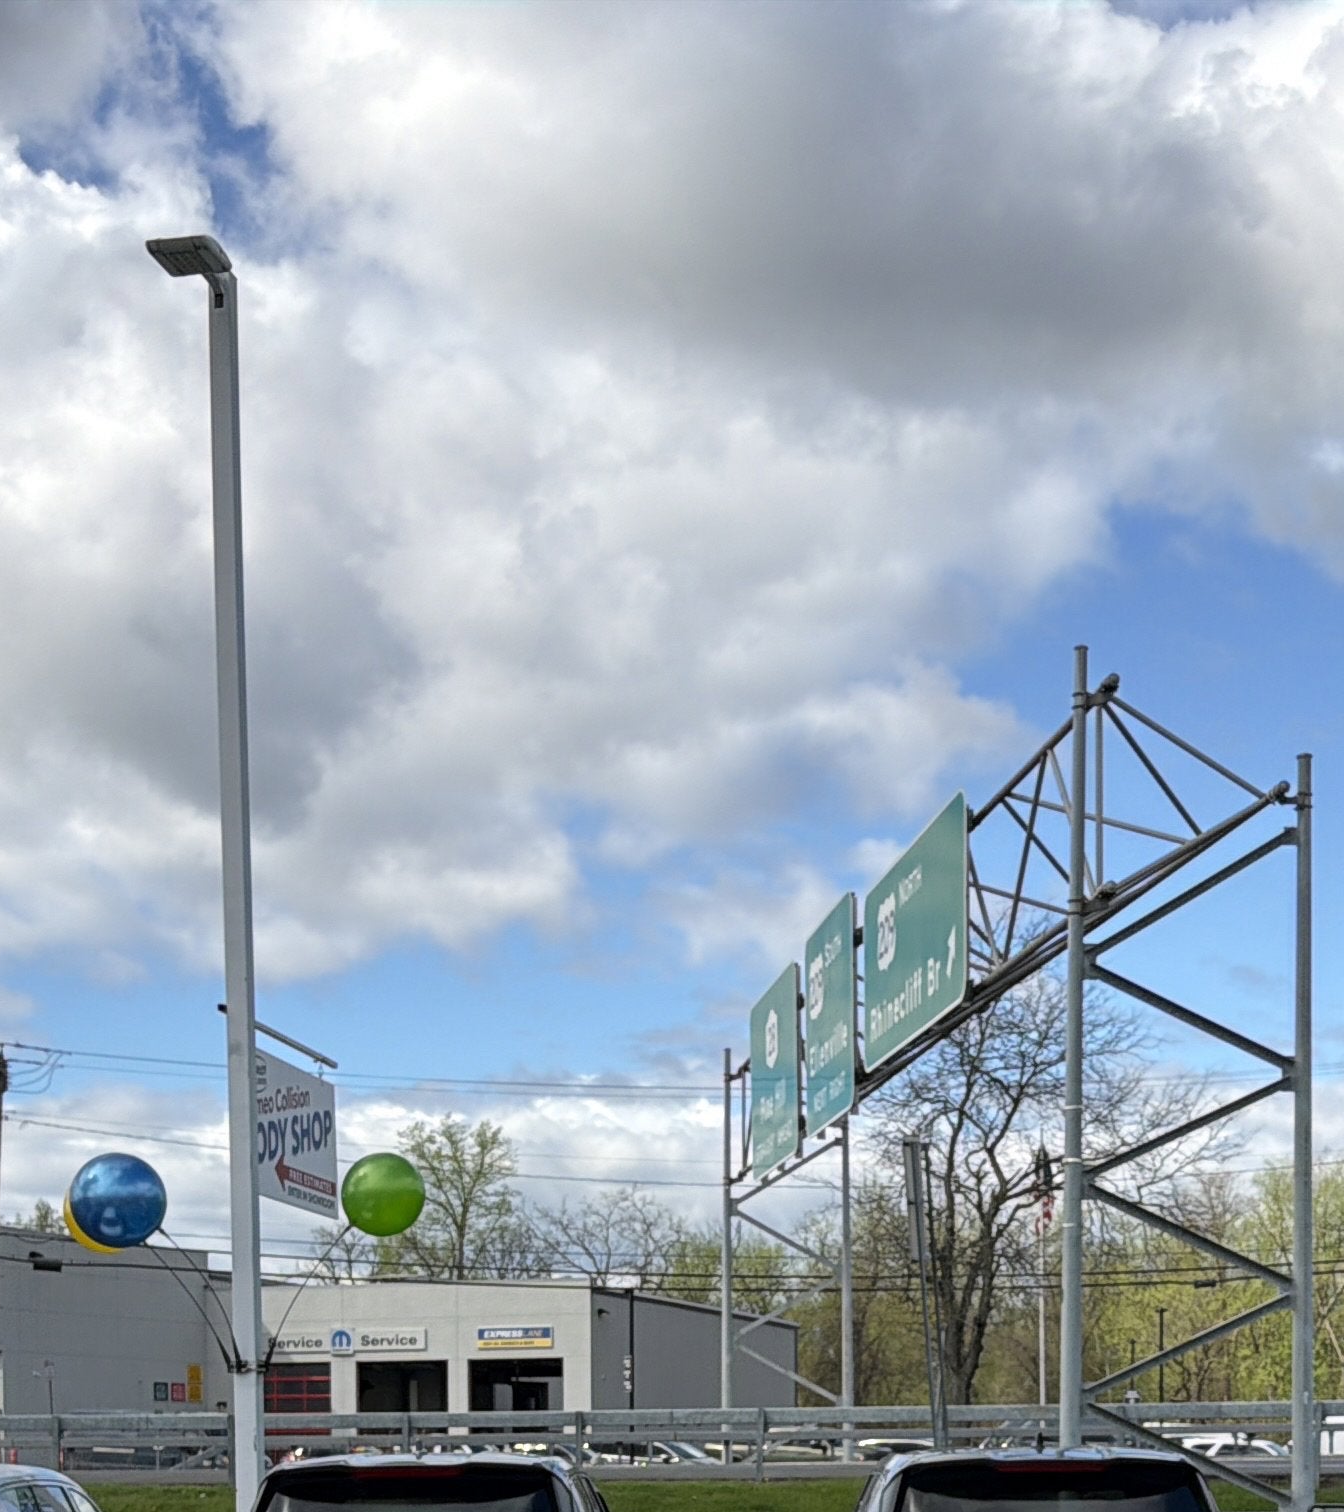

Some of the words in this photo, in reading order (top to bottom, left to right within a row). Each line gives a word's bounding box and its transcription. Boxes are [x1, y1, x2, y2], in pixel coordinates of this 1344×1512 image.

[869, 967, 922, 1043] Rhinecliff
[927, 957, 941, 997] Br
[275, 1084, 311, 1113] Collision
[257, 1117, 289, 1164] ODY
[291, 1109, 332, 1156] SHOP
[268, 1335, 323, 1350] Service
[360, 1334, 418, 1348] Service
